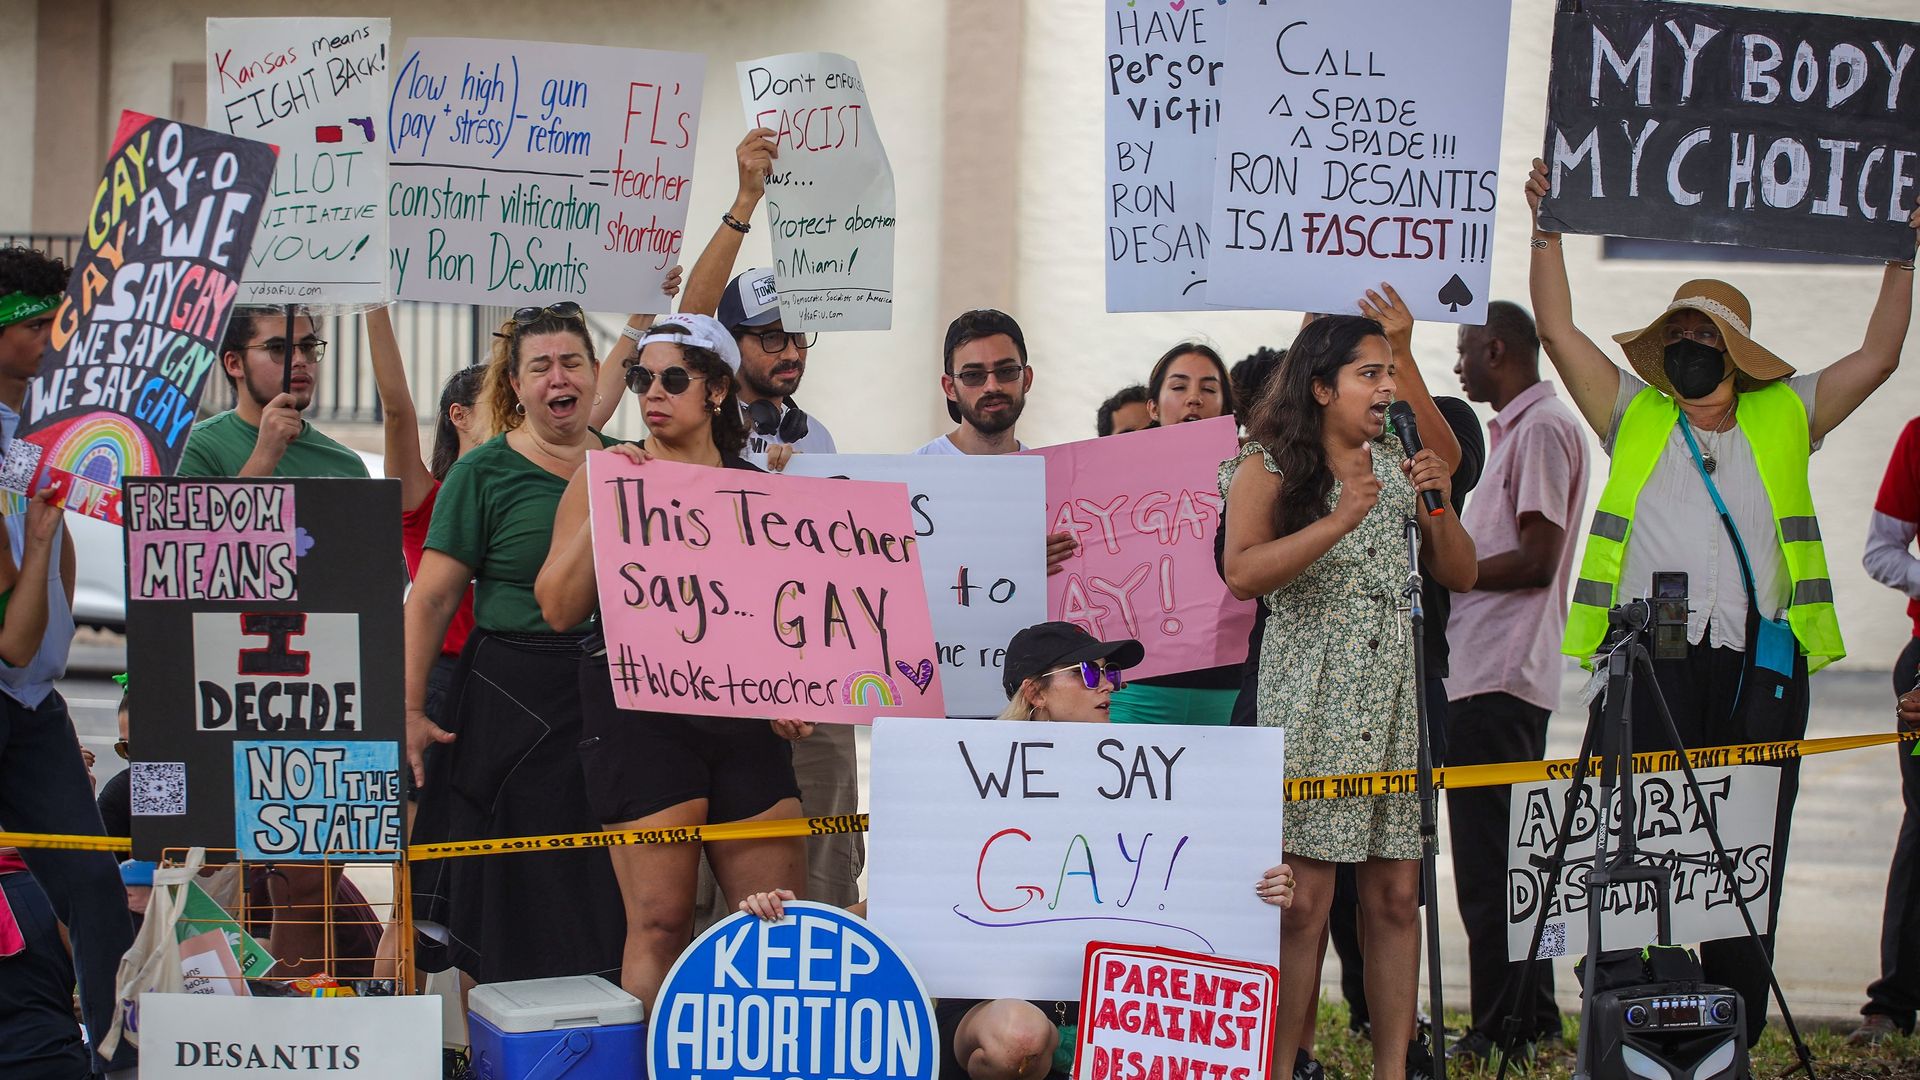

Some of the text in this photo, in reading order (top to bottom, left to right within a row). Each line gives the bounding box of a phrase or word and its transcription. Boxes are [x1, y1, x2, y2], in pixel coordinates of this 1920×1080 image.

[1117, 8, 1207, 46] HAVE
[1277, 21, 1386, 77] CALL
[215, 25, 370, 94] Kansas means
[748, 68, 815, 101] Don't
[1590, 19, 1915, 110] MY BODY
[225, 43, 386, 135] FIGHT BACK!
[541, 79, 587, 120] gun
[624, 82, 690, 149] FL's
[1127, 97, 1220, 134] victi
[1269, 89, 1416, 126] A SPADE
[527, 116, 591, 156] reform
[757, 105, 861, 152] FASCIST
[1290, 122, 1456, 160] A SPADE!!!
[271, 152, 363, 197] LLOT
[611, 149, 690, 201] teacher
[1117, 141, 1153, 174] BY
[1230, 152, 1497, 213] RON DESANTIS
[1551, 119, 1919, 222] MY CHOICE
[389, 177, 600, 235] constant vilification
[769, 201, 896, 241] Protect abortion
[1112, 181, 1175, 218] RON
[161, 192, 252, 267] WE
[604, 211, 682, 270] shortage
[390, 228, 589, 295] y Ron DeSantis
[792, 247, 858, 278] Miami!
[91, 261, 238, 341] SAY GAY
[65, 322, 216, 398] WE SAY GAY
[30, 366, 195, 449] WE SAY GAY
[128, 484, 284, 533] FREEDOM
[605, 477, 916, 566] This Teacher
[1046, 495, 1129, 557] AY
[141, 541, 297, 600] MEANS
[950, 566, 1016, 607] to
[238, 612, 310, 676] I
[773, 580, 890, 678] GAY
[199, 680, 356, 731] DECIDE
[246, 746, 399, 801] NOT THE
[958, 739, 1187, 800] WE SAY
[1382, 772, 1445, 794] PLICE
[1691, 748, 1731, 769] LINE
[1299, 780, 1325, 800] DO
[1332, 776, 1373, 798] LINE
[253, 804, 401, 856] STATE
[977, 828, 1189, 912] GAY!
[714, 915, 880, 993] KEEP
[1104, 960, 1261, 1012] PARENTS
[667, 993, 921, 1078] ABORTION
[1095, 998, 1257, 1051] AGAINST
[175, 1041, 361, 1070] DESANTIS
